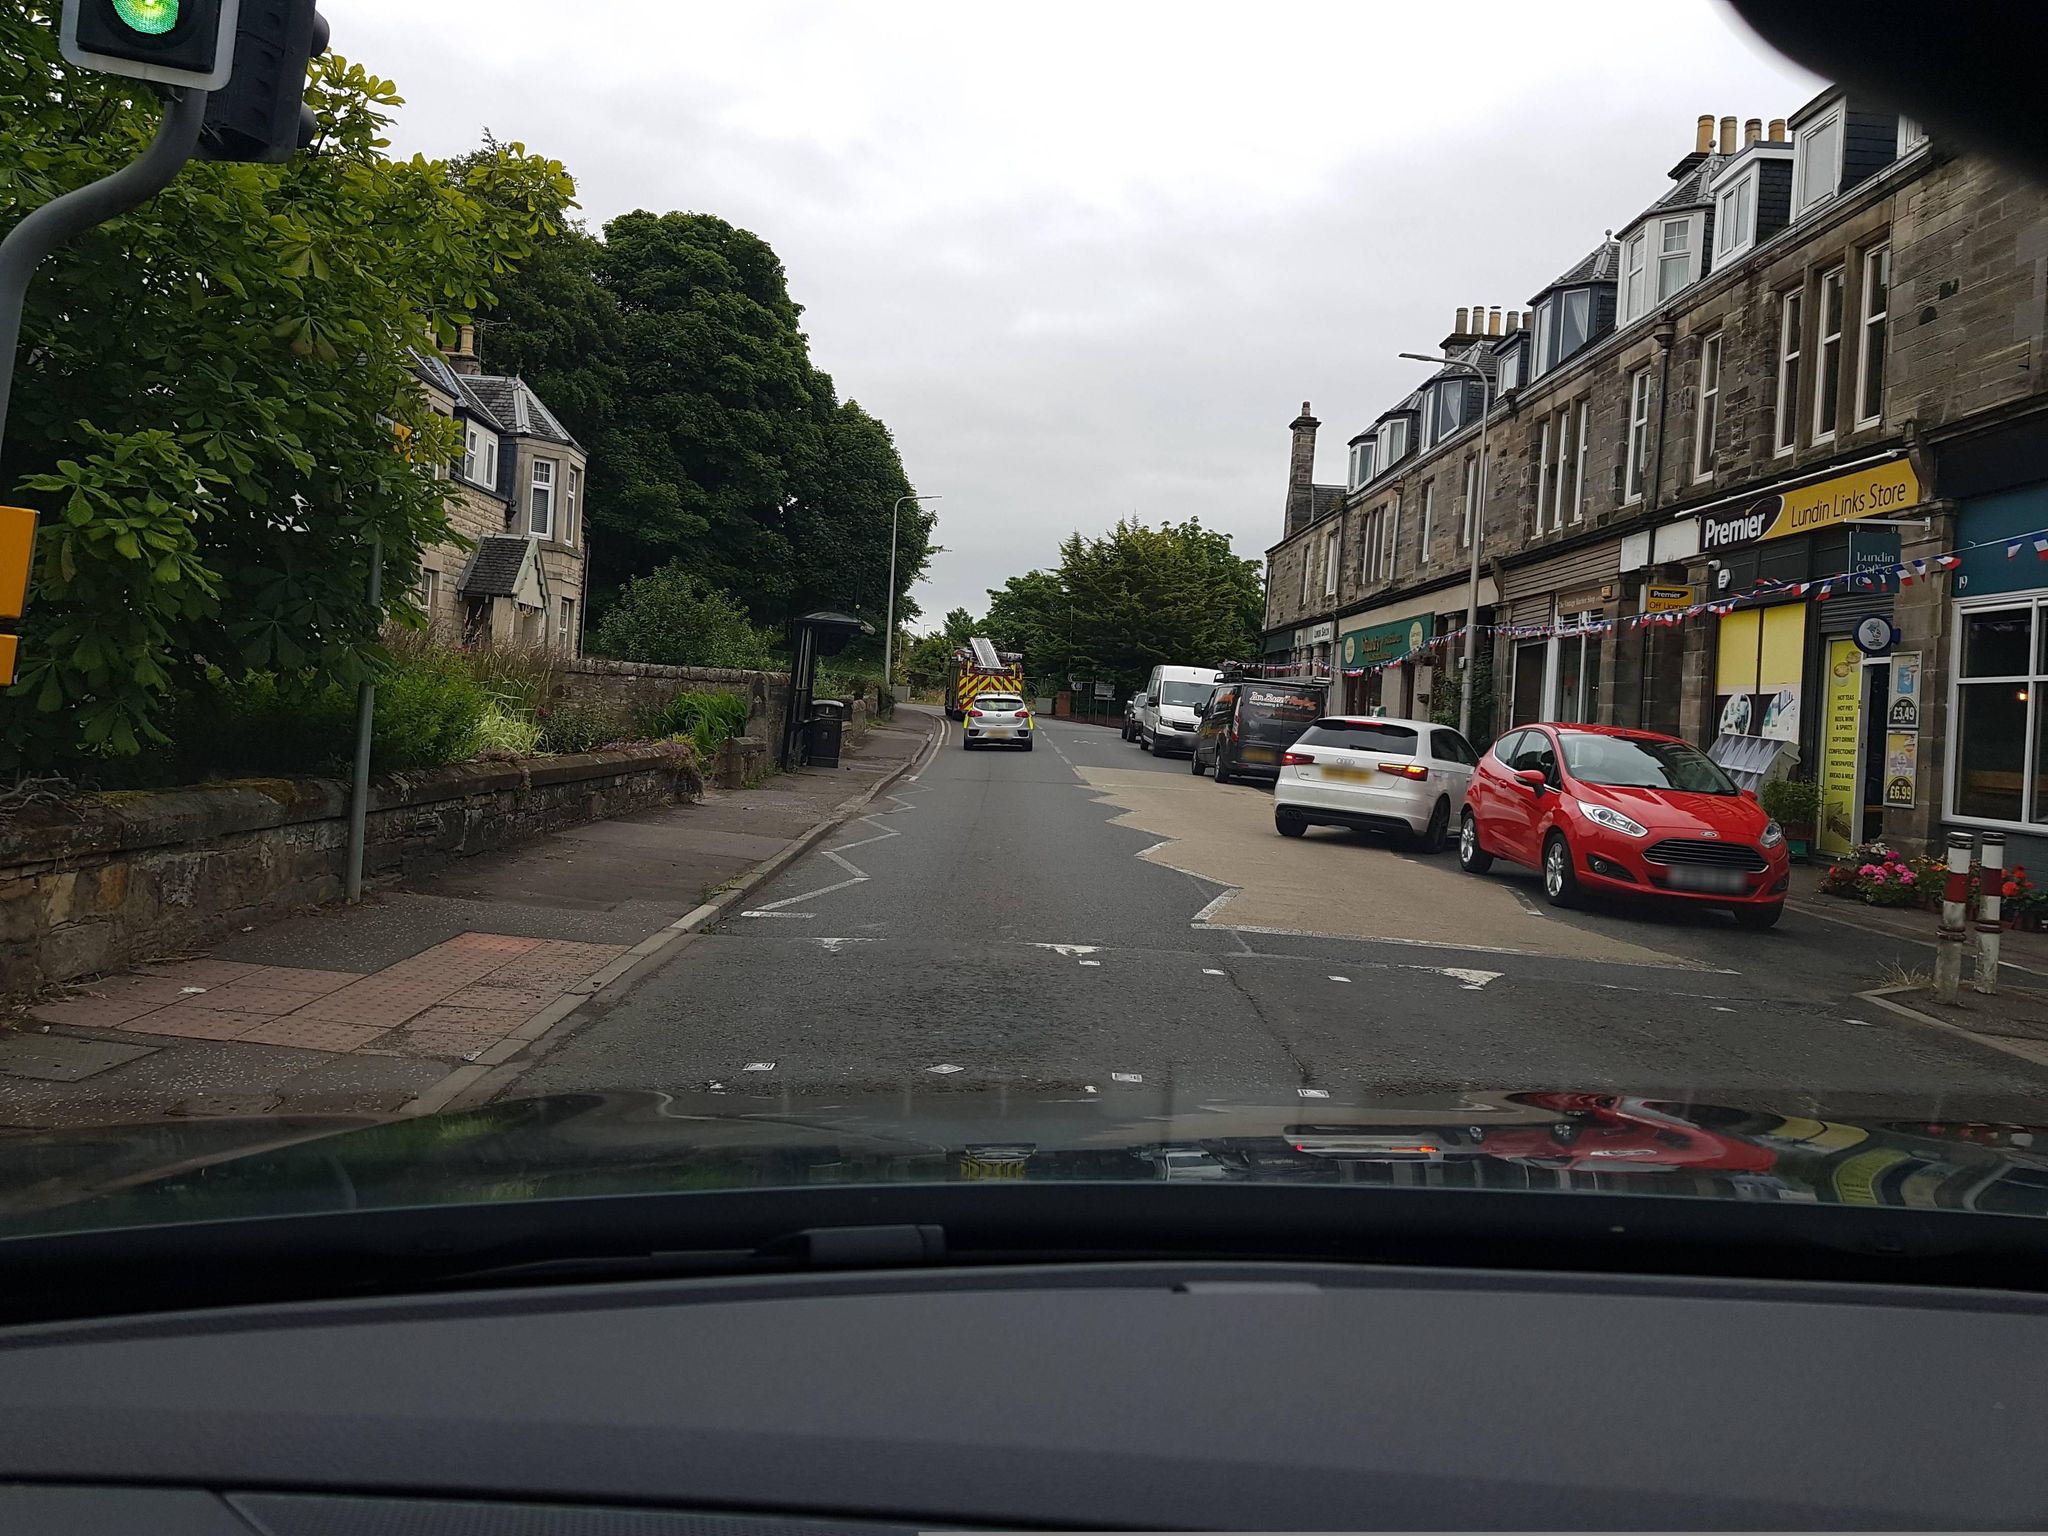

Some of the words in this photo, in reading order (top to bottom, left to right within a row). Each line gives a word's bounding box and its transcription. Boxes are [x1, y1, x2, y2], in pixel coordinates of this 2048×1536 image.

[1704, 509, 1766, 548] Premier
[1791, 500, 1830, 528] Lundin
[1833, 490, 1865, 518] Links
[1869, 482, 1906, 509] Store
[1857, 551, 1895, 563] Lundin
[1959, 575, 1968, 590] 19
[1653, 590, 1681, 599] Premier
[1649, 601, 1662, 609] Off
[1893, 706, 1915, 720] £3.49
[1890, 785, 1912, 800] £6.99
